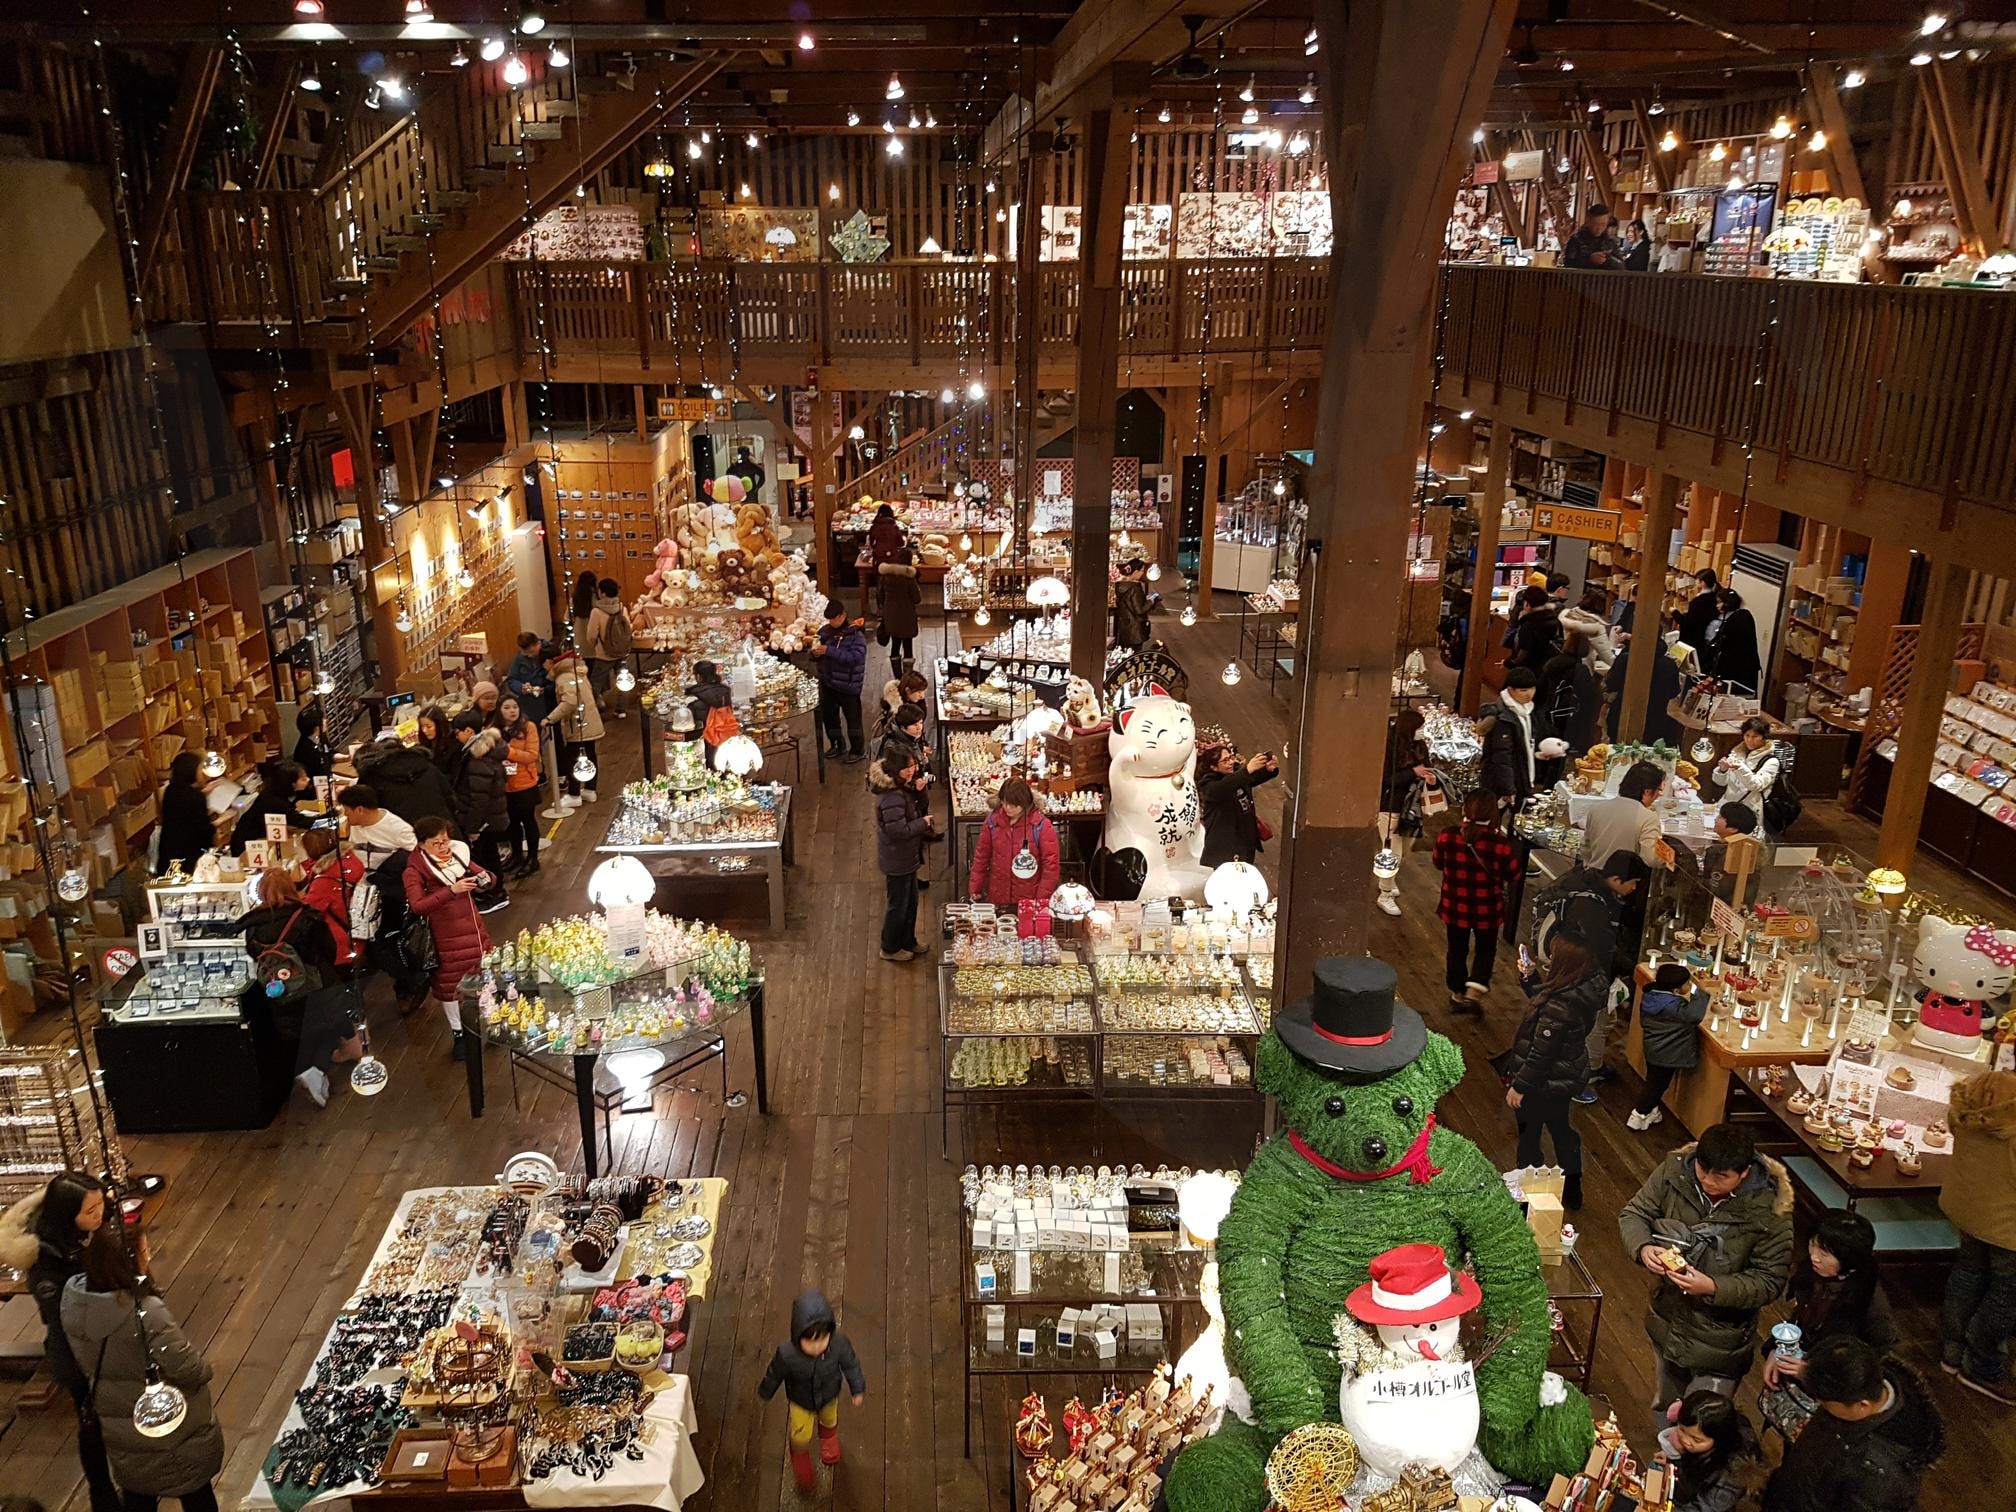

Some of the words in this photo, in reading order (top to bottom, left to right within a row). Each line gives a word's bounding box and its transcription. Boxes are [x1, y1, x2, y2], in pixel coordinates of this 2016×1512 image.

[675, 402, 712, 412] TOILET
[1557, 513, 1612, 530] CASHIER
[1513, 576, 1520, 585] 3
[272, 827, 281, 840] 3
[253, 853, 263, 866] 4
[1372, 1370, 1472, 1398] 小樽オルゴール堂
